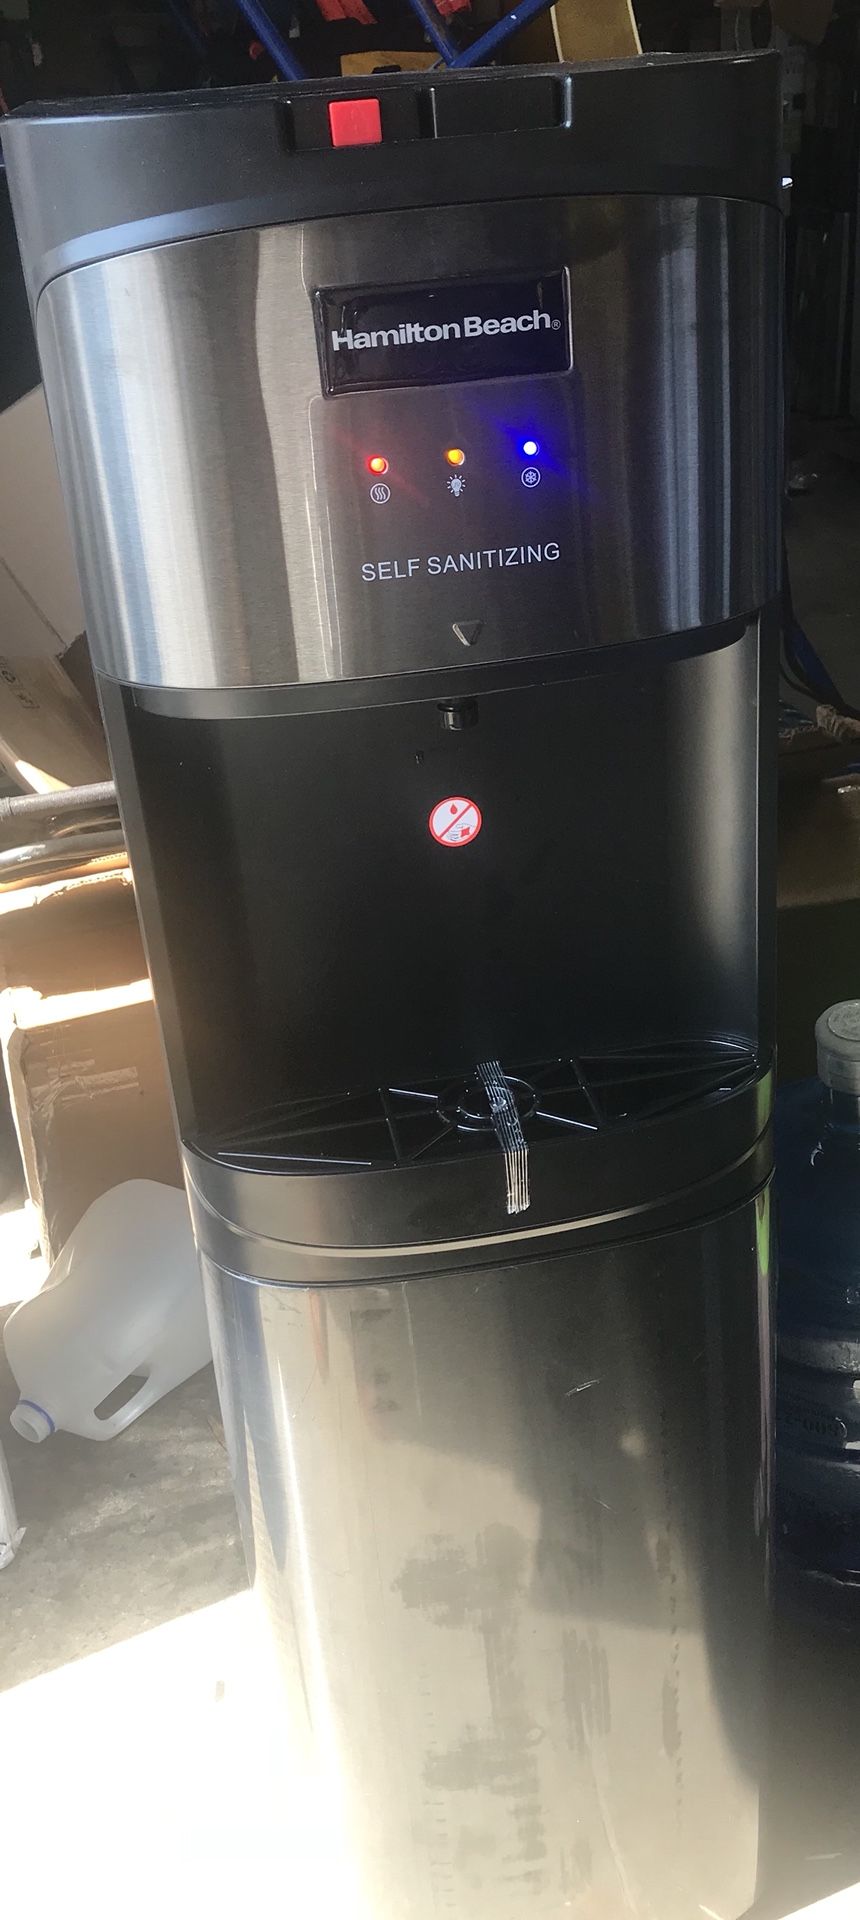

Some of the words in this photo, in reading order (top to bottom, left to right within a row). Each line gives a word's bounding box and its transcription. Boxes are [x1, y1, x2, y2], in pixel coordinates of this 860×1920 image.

[331, 320, 462, 352] Hamilton
[361, 558, 420, 582] SELF
[427, 542, 560, 576] SANITIZING
